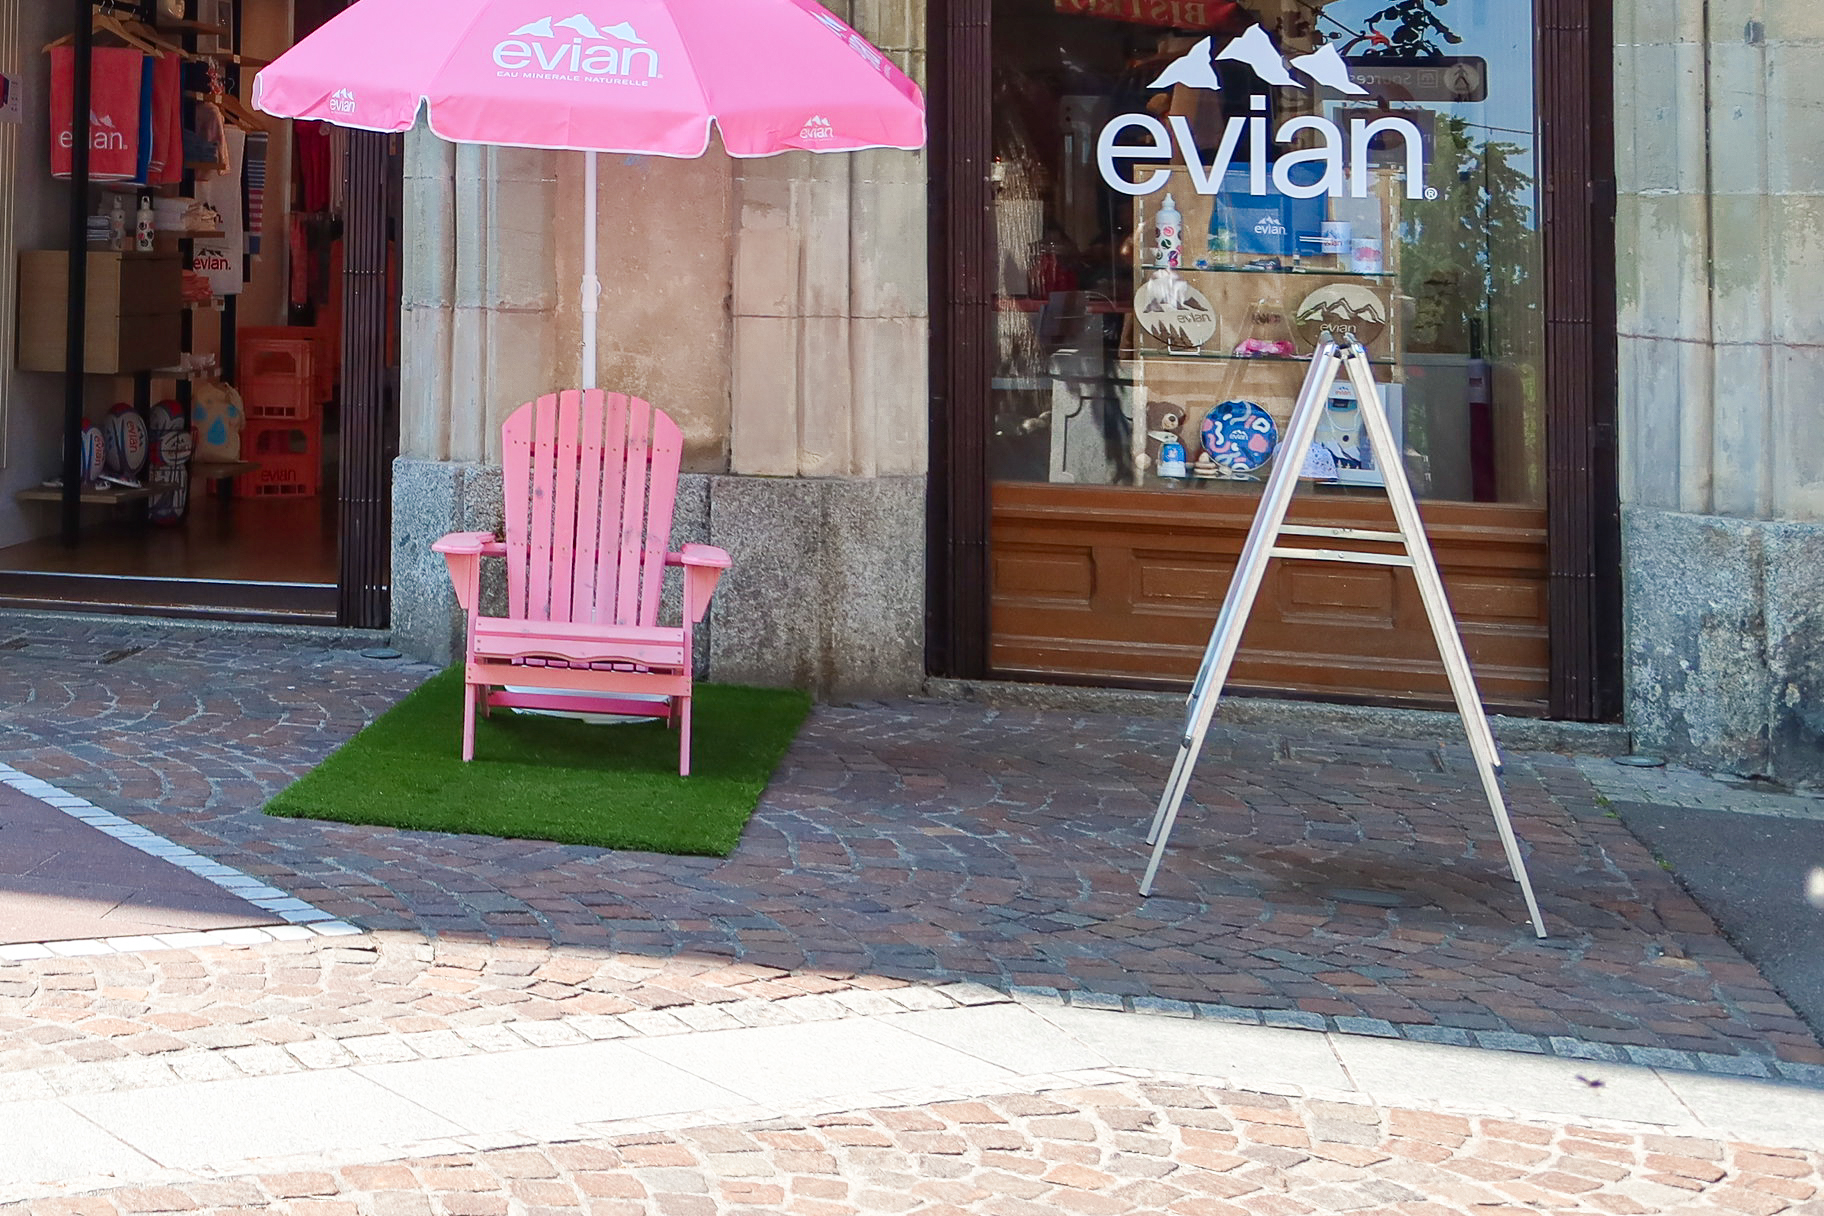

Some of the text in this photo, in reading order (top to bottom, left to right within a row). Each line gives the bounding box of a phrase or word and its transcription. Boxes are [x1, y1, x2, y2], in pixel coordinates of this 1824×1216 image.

[492, 37, 660, 79] evian
[496, 70, 649, 87] EAU MINERALE NATURELLE
[329, 97, 357, 113] evian
[59, 127, 129, 150] eian
[799, 125, 834, 139] evian
[1254, 224, 1287, 236] evian
[1177, 313, 1212, 325] evian
[1320, 322, 1357, 334] evian
[260, 467, 297, 482] evian
